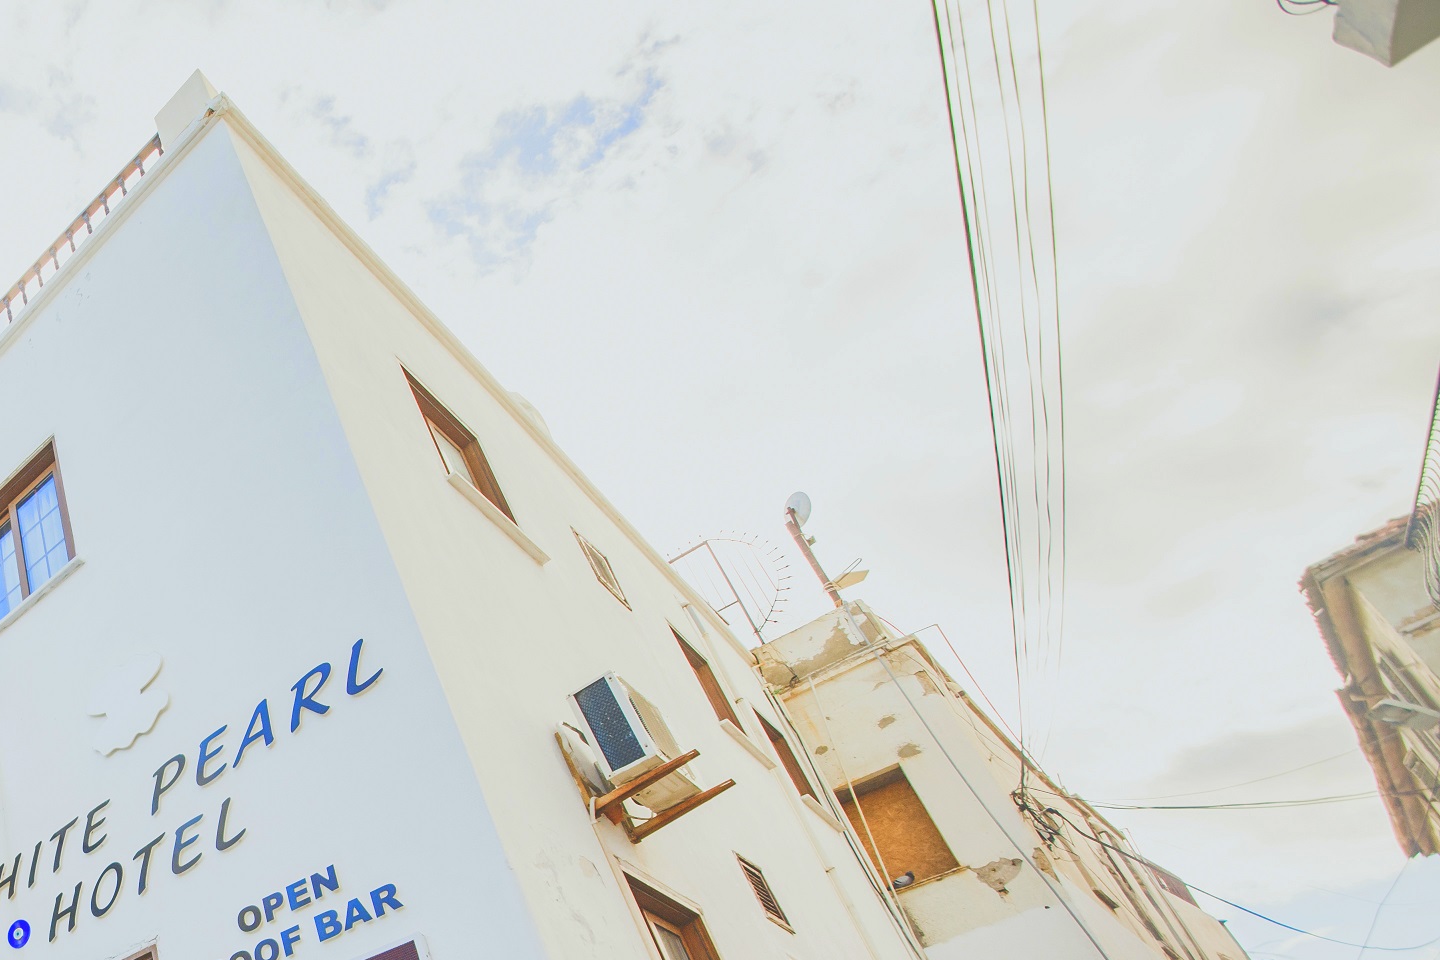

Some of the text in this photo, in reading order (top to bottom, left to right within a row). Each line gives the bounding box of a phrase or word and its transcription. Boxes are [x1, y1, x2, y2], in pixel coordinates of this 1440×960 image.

[151, 638, 385, 817] PEARL
[48, 797, 248, 944] HOTEL
[237, 864, 341, 933] OPEN
[314, 883, 404, 944] BAR
